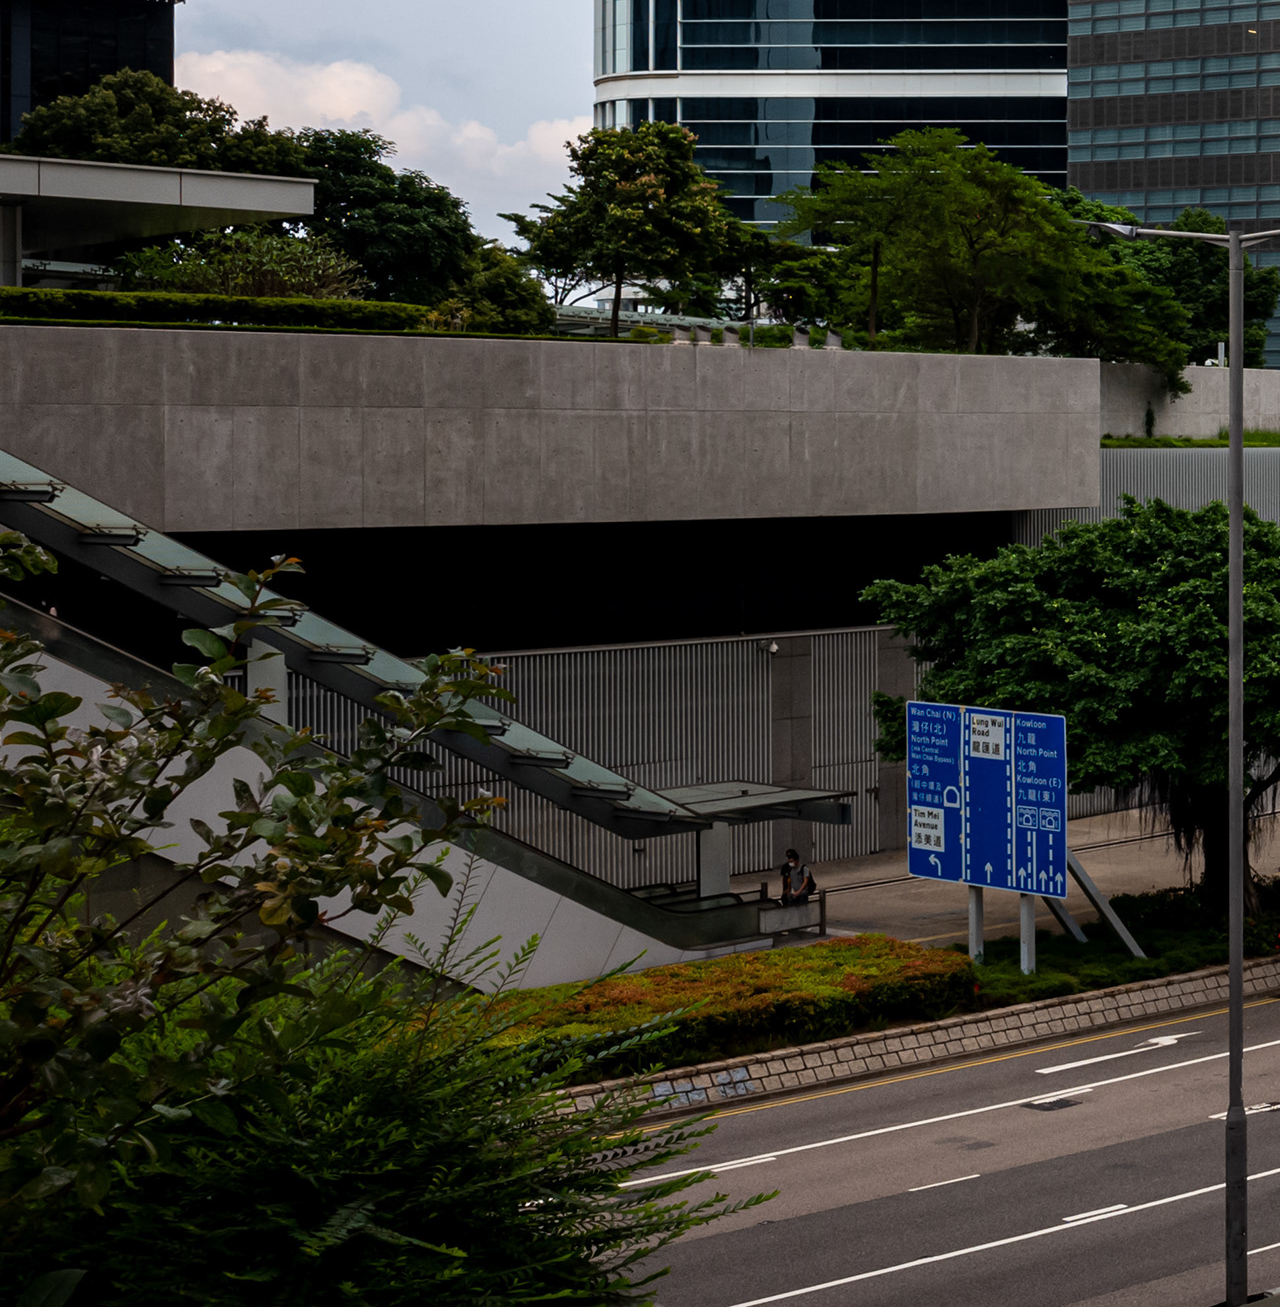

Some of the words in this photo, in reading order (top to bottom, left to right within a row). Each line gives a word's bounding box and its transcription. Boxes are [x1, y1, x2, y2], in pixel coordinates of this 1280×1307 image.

[910, 707, 925, 717] Wan
[926, 708, 941, 718] Chai
[942, 710, 956, 721] (N)
[972, 717, 989, 728] Lung
[991, 718, 1004, 728] Wui
[1016, 718, 1046, 729] Kowloon
[972, 727, 990, 738] Road
[1017, 732, 1036, 745] 九龍
[911, 734, 930, 744] North
[931, 736, 948, 746] Point
[921, 746, 940, 754] Central
[1016, 746, 1037, 757] North
[1038, 748, 1058, 759] Point
[911, 752, 921, 760] Wan
[922, 753, 933, 761] Chai
[911, 763, 930, 777] 北角
[1017, 760, 1037, 773] 北角
[1016, 774, 1047, 786] Kowloon
[1048, 778, 1062, 789] (E)
[914, 809, 926, 819] Tim
[927, 810, 940, 820] Mei
[914, 819, 939, 831] Avenue
